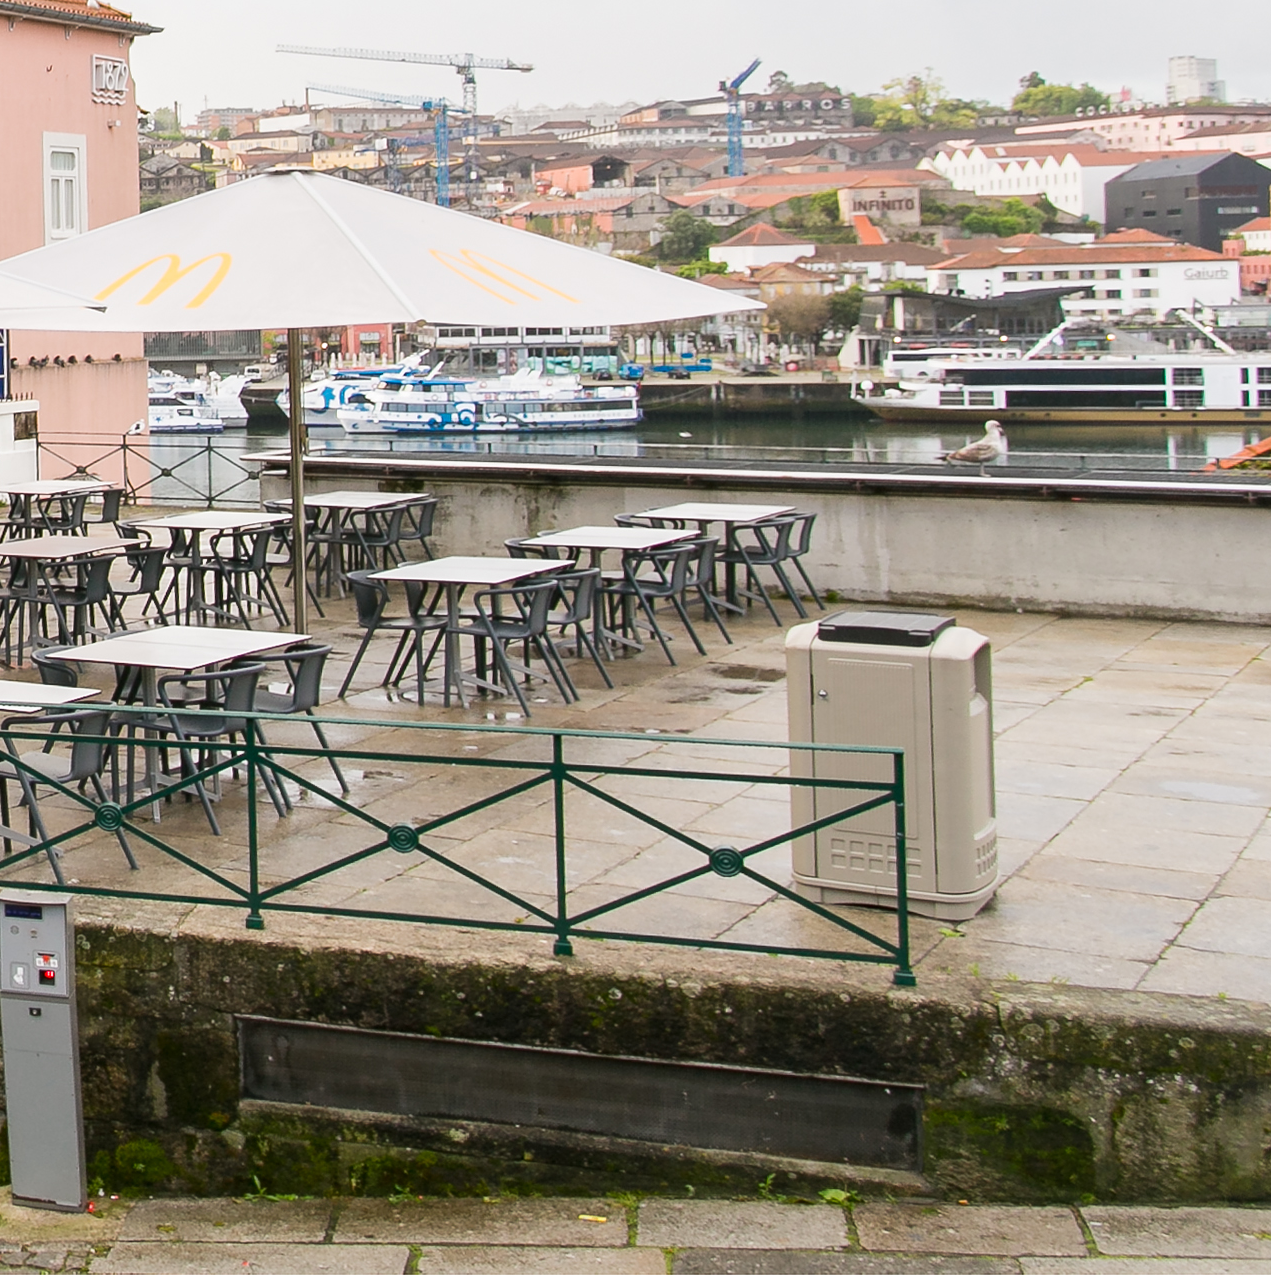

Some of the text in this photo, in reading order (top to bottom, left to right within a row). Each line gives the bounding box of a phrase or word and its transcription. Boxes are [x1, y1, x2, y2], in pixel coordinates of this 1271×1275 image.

[94, 61, 130, 92] 1872
[746, 98, 852, 112] BARROS
[852, 198, 915, 212] INFINITO
[1184, 267, 1229, 278] Gaiurb
